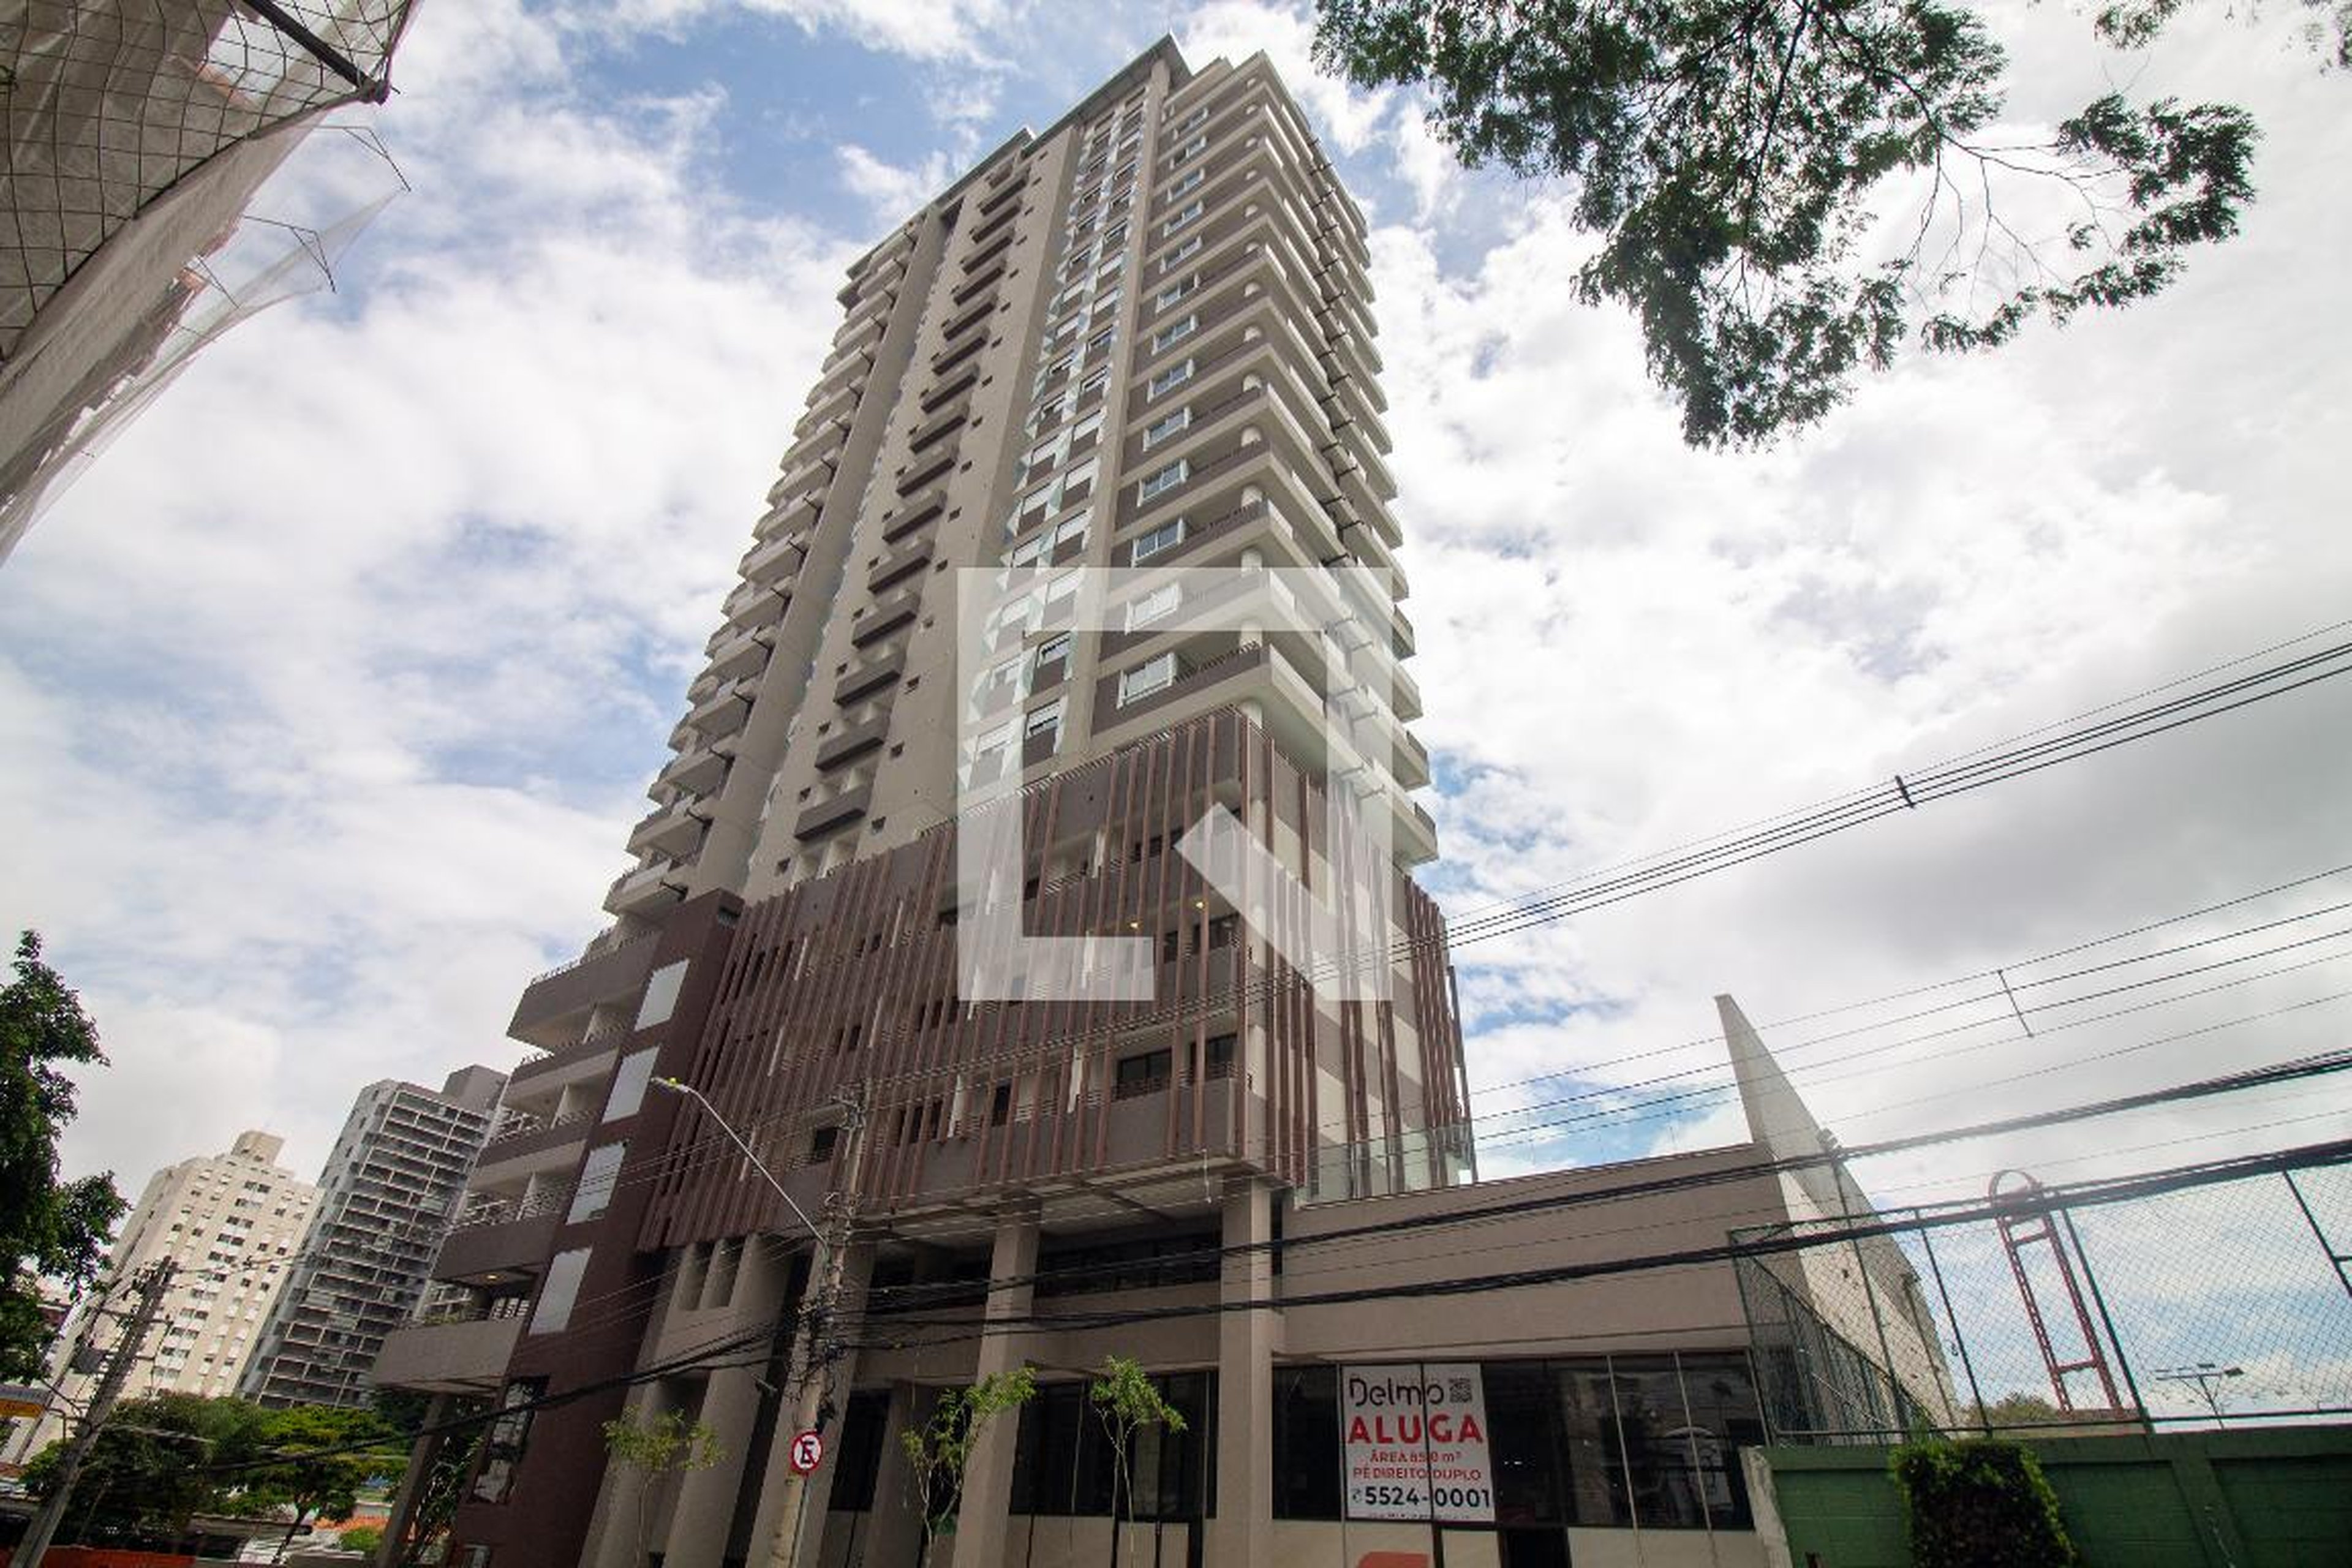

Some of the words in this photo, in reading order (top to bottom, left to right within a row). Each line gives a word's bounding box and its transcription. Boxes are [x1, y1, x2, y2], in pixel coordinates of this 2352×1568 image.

[1349, 1378, 1444, 1406] Delmo
[1348, 1414, 1483, 1444] ALUGA
[1373, 1468, 1427, 1479] DIREITO
[1433, 1469, 1481, 1481] DUPLO
[1365, 1487, 1490, 1507] 5524-0001
